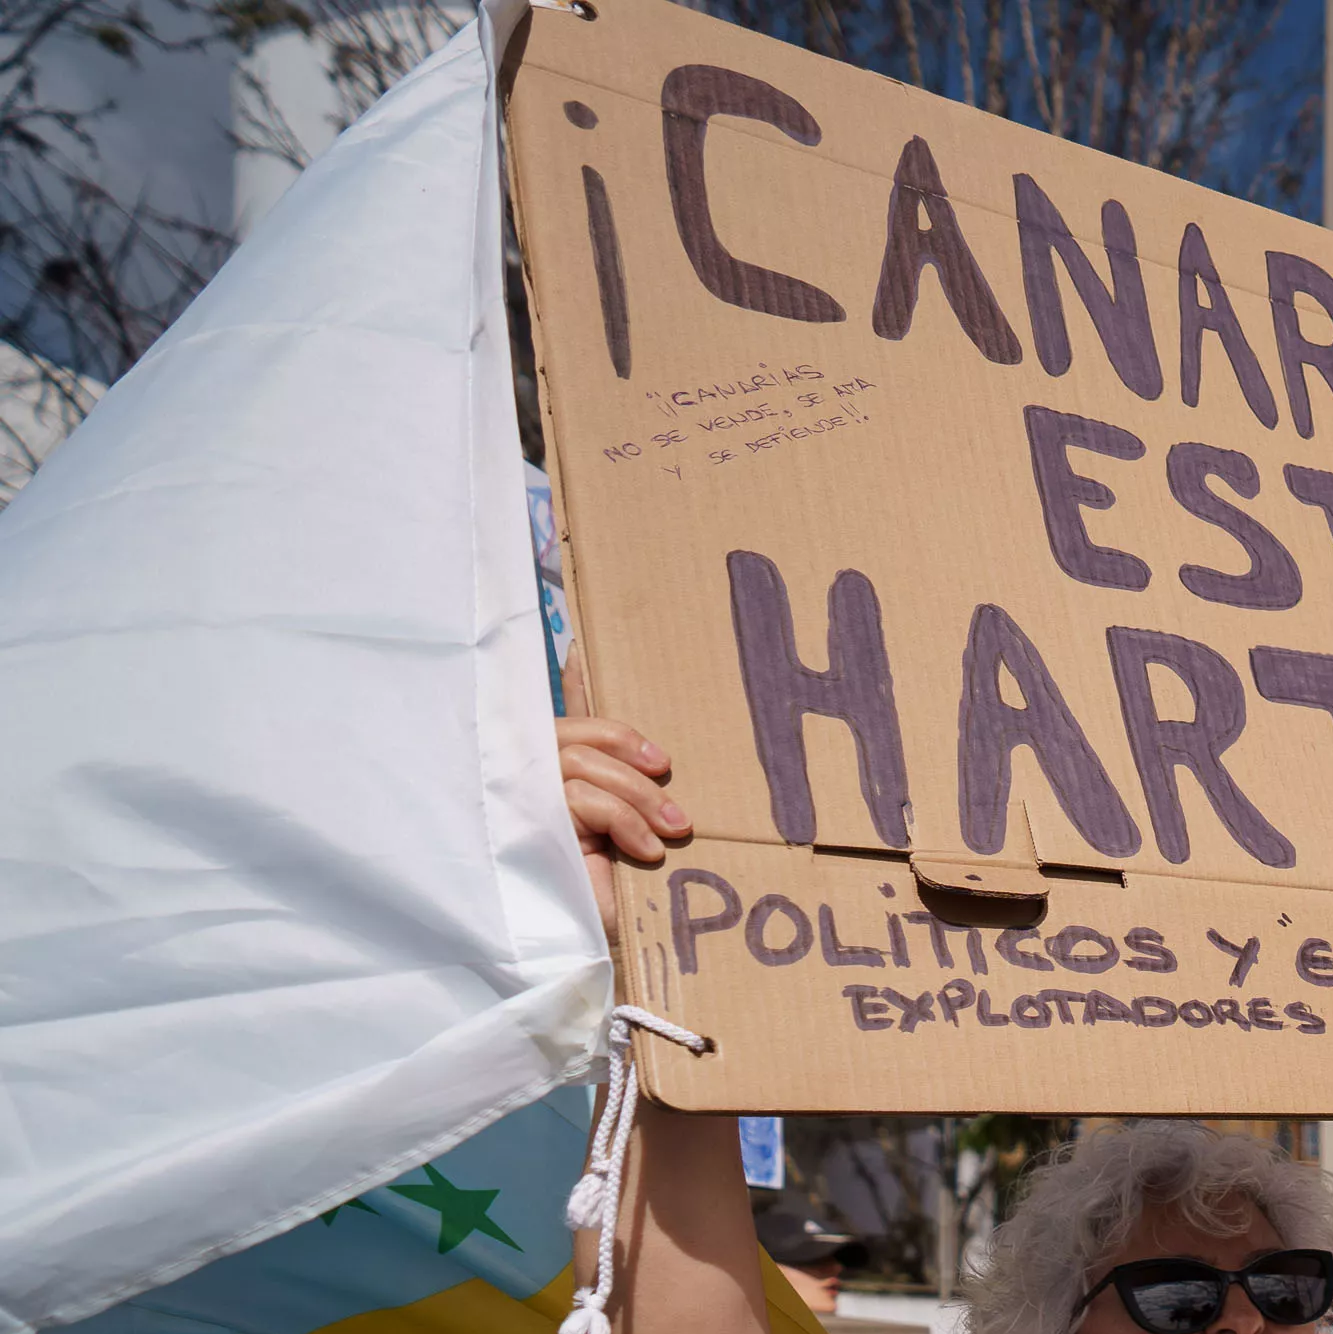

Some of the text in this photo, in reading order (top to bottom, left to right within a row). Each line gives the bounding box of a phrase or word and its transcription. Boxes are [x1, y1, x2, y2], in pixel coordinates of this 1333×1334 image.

[603, 442, 642, 464] NO
[650, 429, 689, 448] SE
[797, 392, 825, 408] SE
[833, 376, 877, 398] AMA
[662, 464, 683, 482] Y
[708, 449, 739, 466] SE
[1205, 927, 1261, 987] Y
[842, 977, 1327, 1034] EXPLOTADORES
